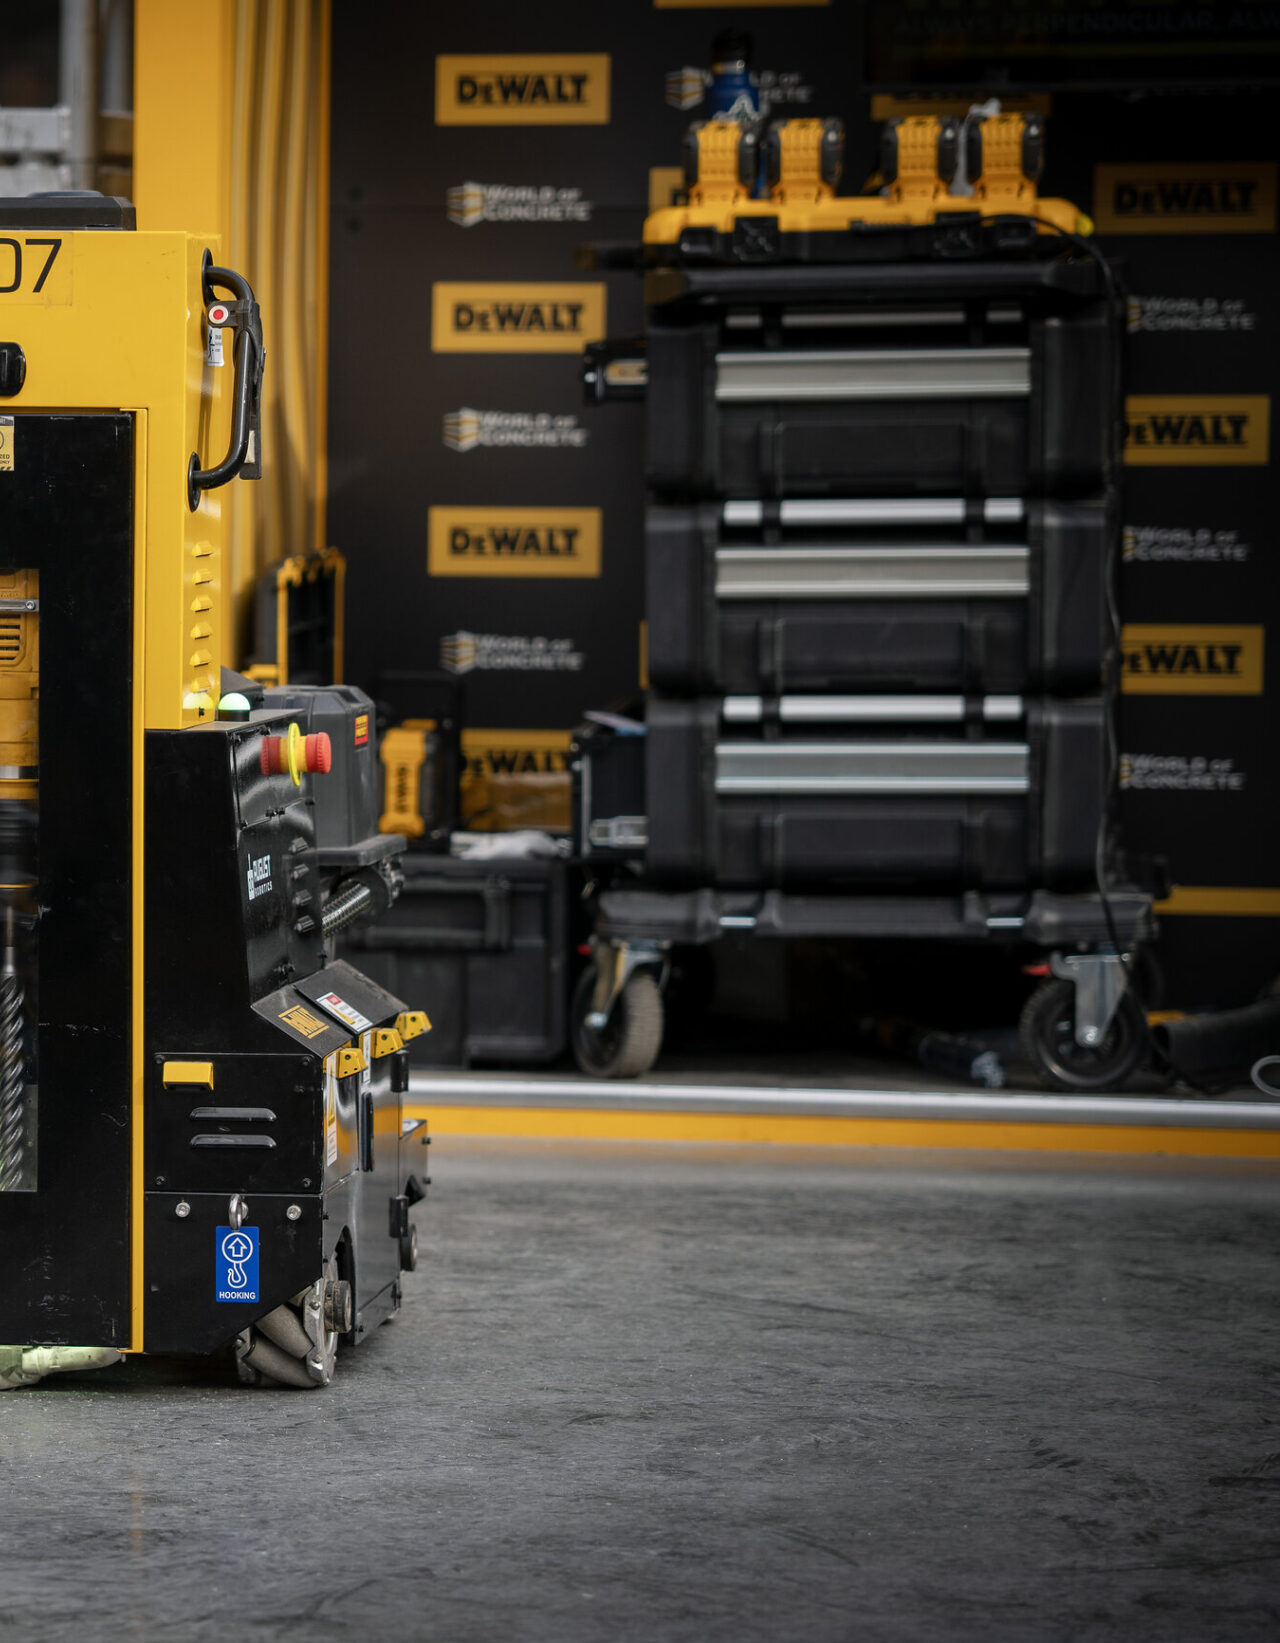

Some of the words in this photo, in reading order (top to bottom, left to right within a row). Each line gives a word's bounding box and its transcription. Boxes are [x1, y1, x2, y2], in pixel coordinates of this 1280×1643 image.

[1124, 414, 1249, 446] EWALT
[1121, 644, 1243, 675] EWALT
[219, 1291, 256, 1300] HOOKING
